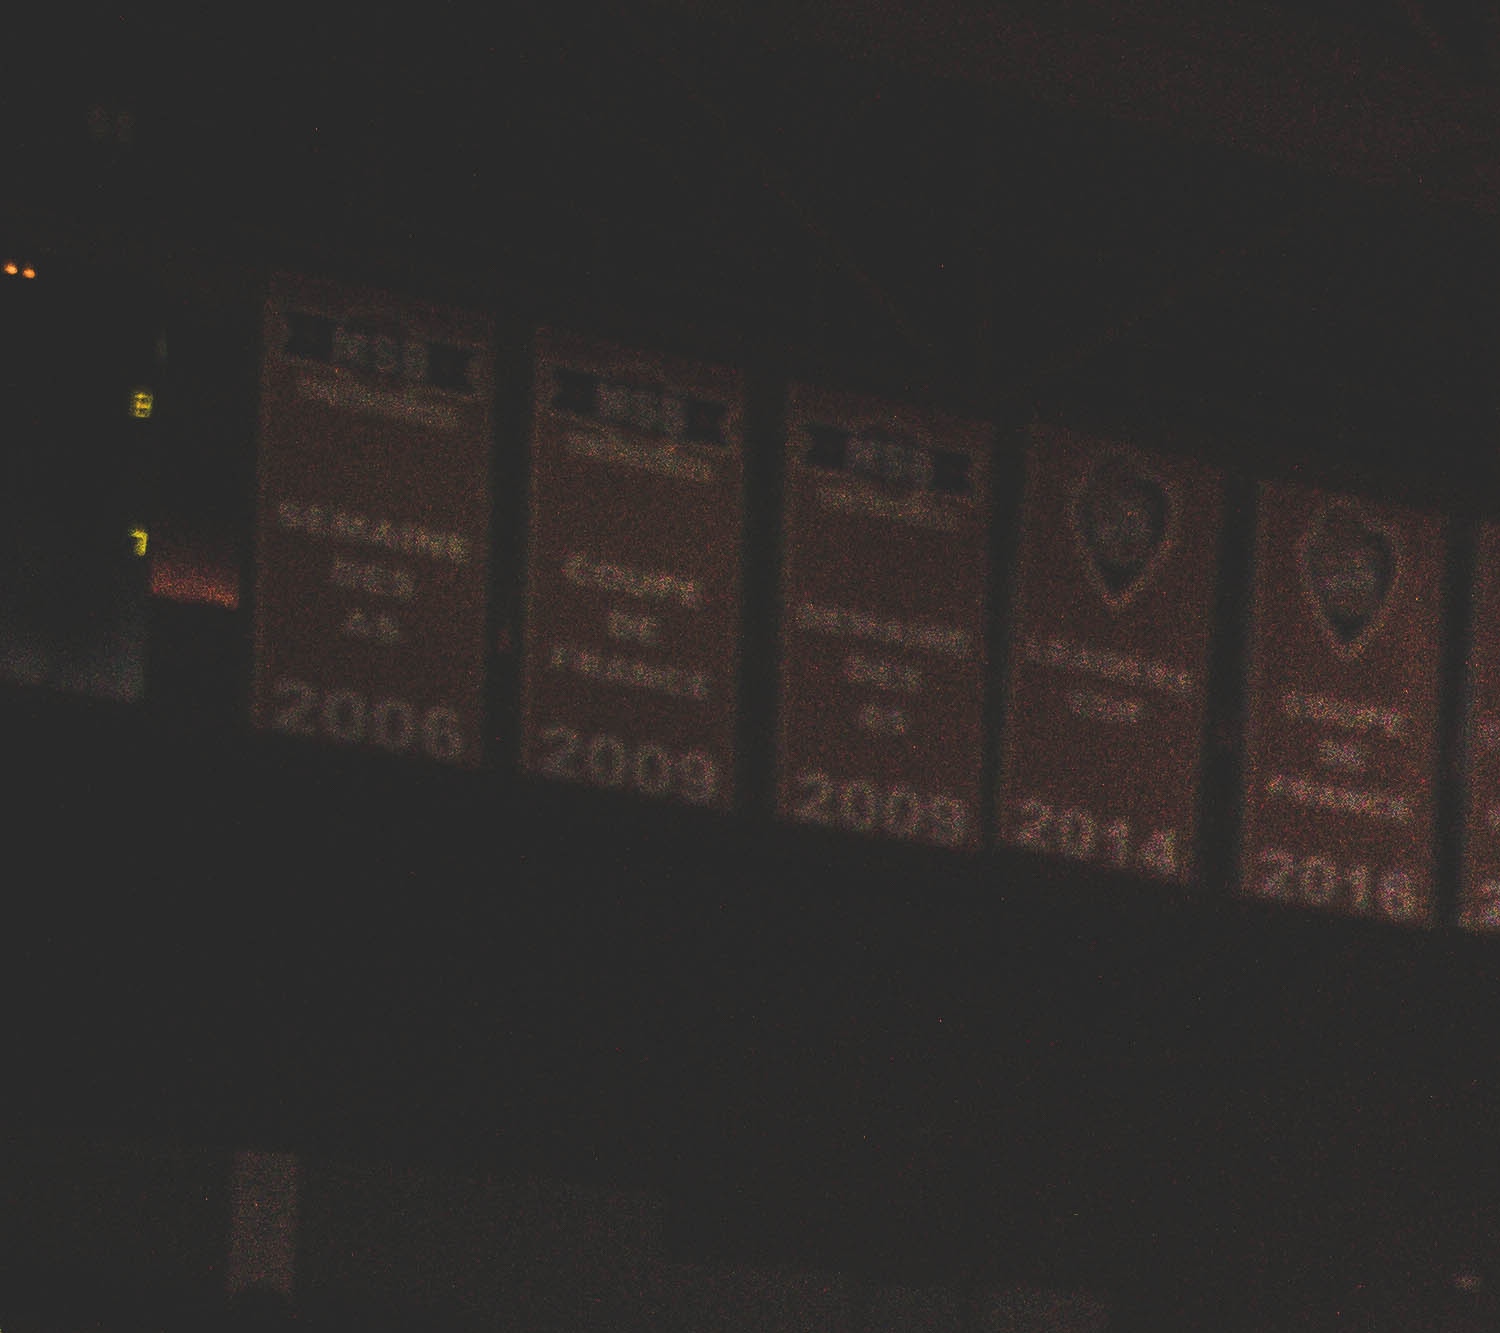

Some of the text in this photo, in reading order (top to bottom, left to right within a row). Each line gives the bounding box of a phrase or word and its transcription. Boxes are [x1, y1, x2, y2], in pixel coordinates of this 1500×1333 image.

[272, 676, 465, 761] 2006
[539, 722, 721, 807] 2009
[794, 769, 968, 847] 2009
[1014, 796, 1180, 876] 2014
[1256, 846, 1417, 918] 2016
